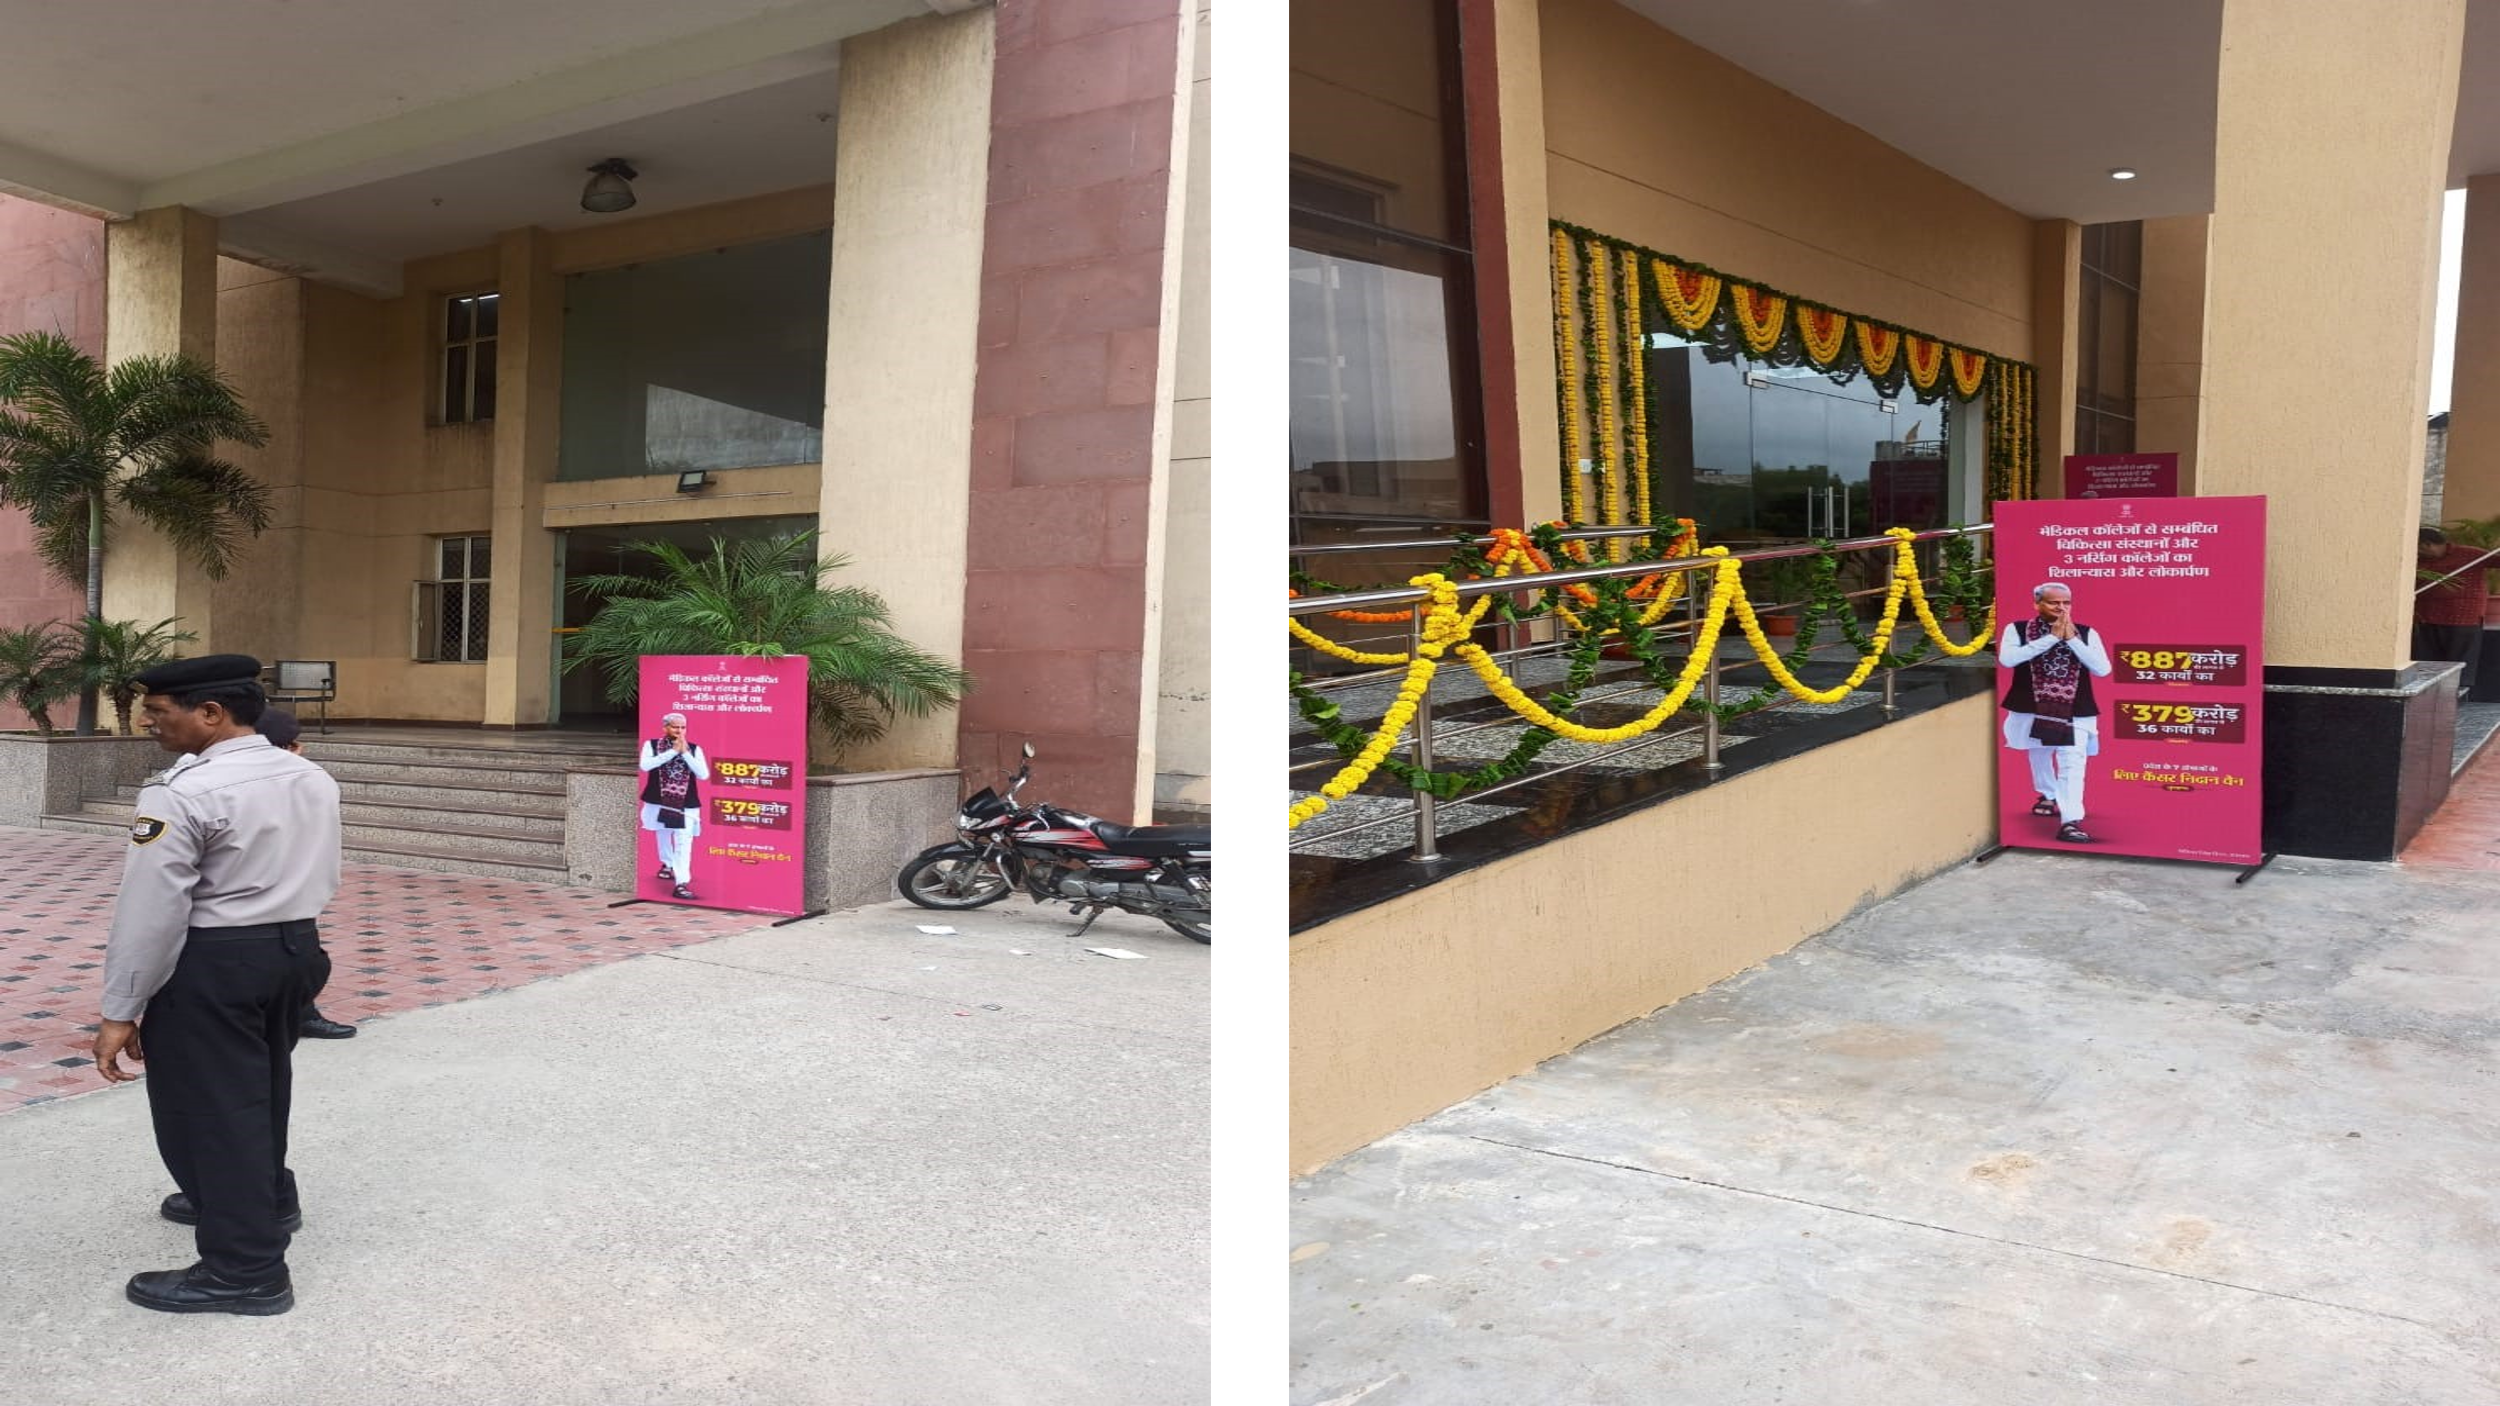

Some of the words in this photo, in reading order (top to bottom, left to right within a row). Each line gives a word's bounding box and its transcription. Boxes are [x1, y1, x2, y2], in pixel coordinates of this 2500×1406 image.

[2091, 523, 2142, 535] कॉलेजों
[2144, 523, 2157, 534] से
[2172, 537, 2199, 549] और
[2063, 554, 2073, 564] 3
[2121, 551, 2171, 563] कॉलेजों
[2172, 553, 2193, 562] का
[2048, 566, 2116, 578] शिलान्यास
[2119, 565, 2145, 577] और
[2148, 565, 2210, 577] लोकार्पण
[2189, 649, 2240, 668] करोड़
[2136, 671, 2156, 680] 32
[2195, 672, 2215, 681] का
[2190, 704, 2240, 722] करोड़
[2137, 724, 2158, 733] 36
[2197, 726, 2216, 735] का
